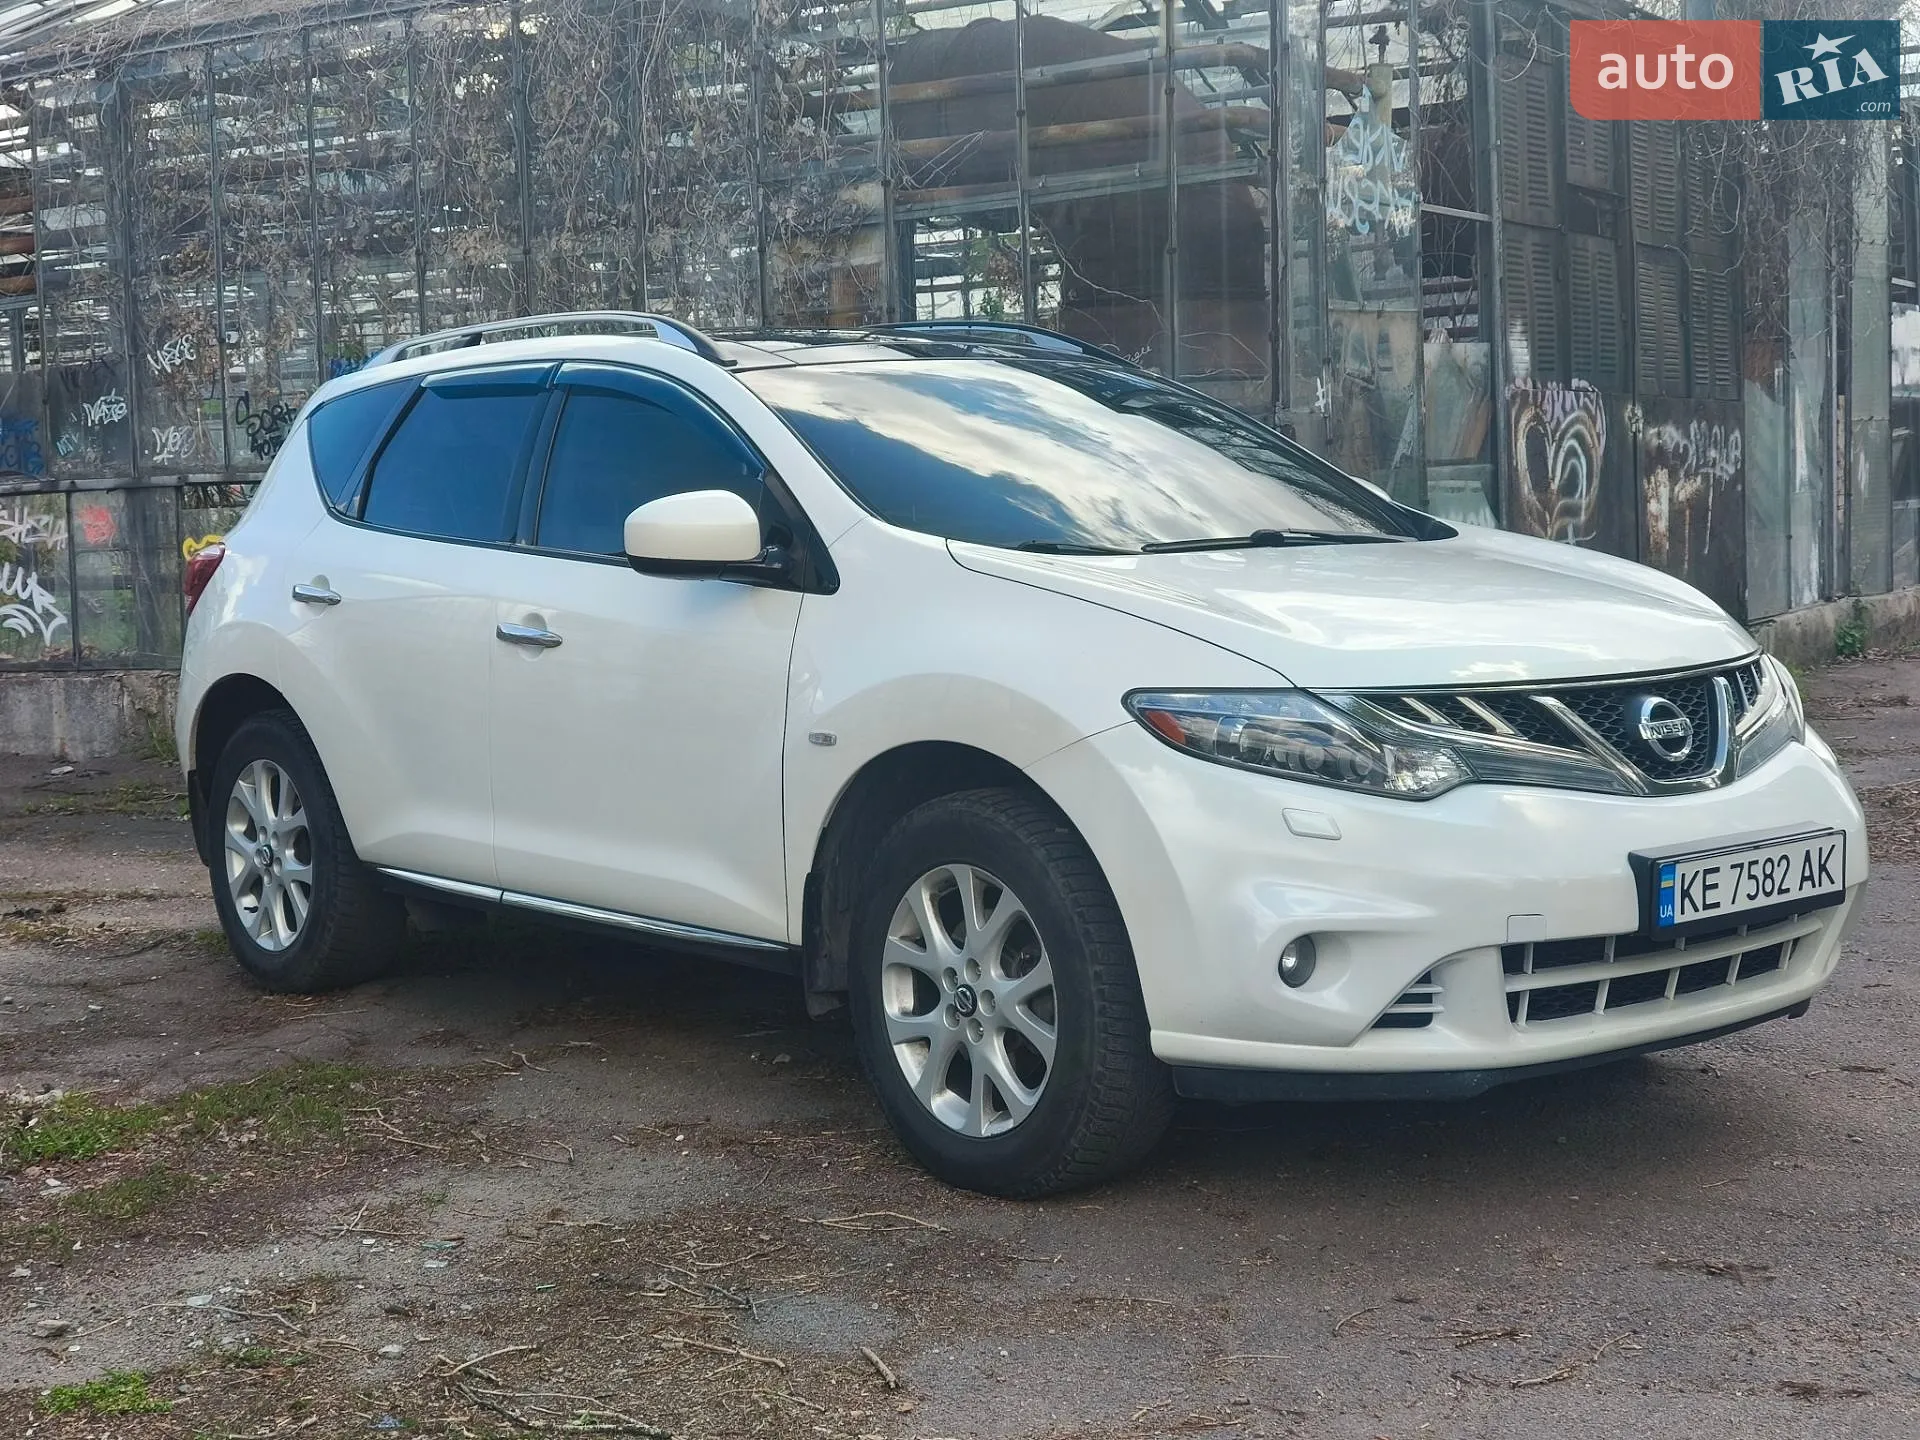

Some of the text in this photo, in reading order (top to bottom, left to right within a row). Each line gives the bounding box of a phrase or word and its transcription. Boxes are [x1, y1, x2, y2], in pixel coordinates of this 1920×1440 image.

[1680, 844, 1836, 915] KE 7582 AK
[1660, 904, 1674, 918] UA
